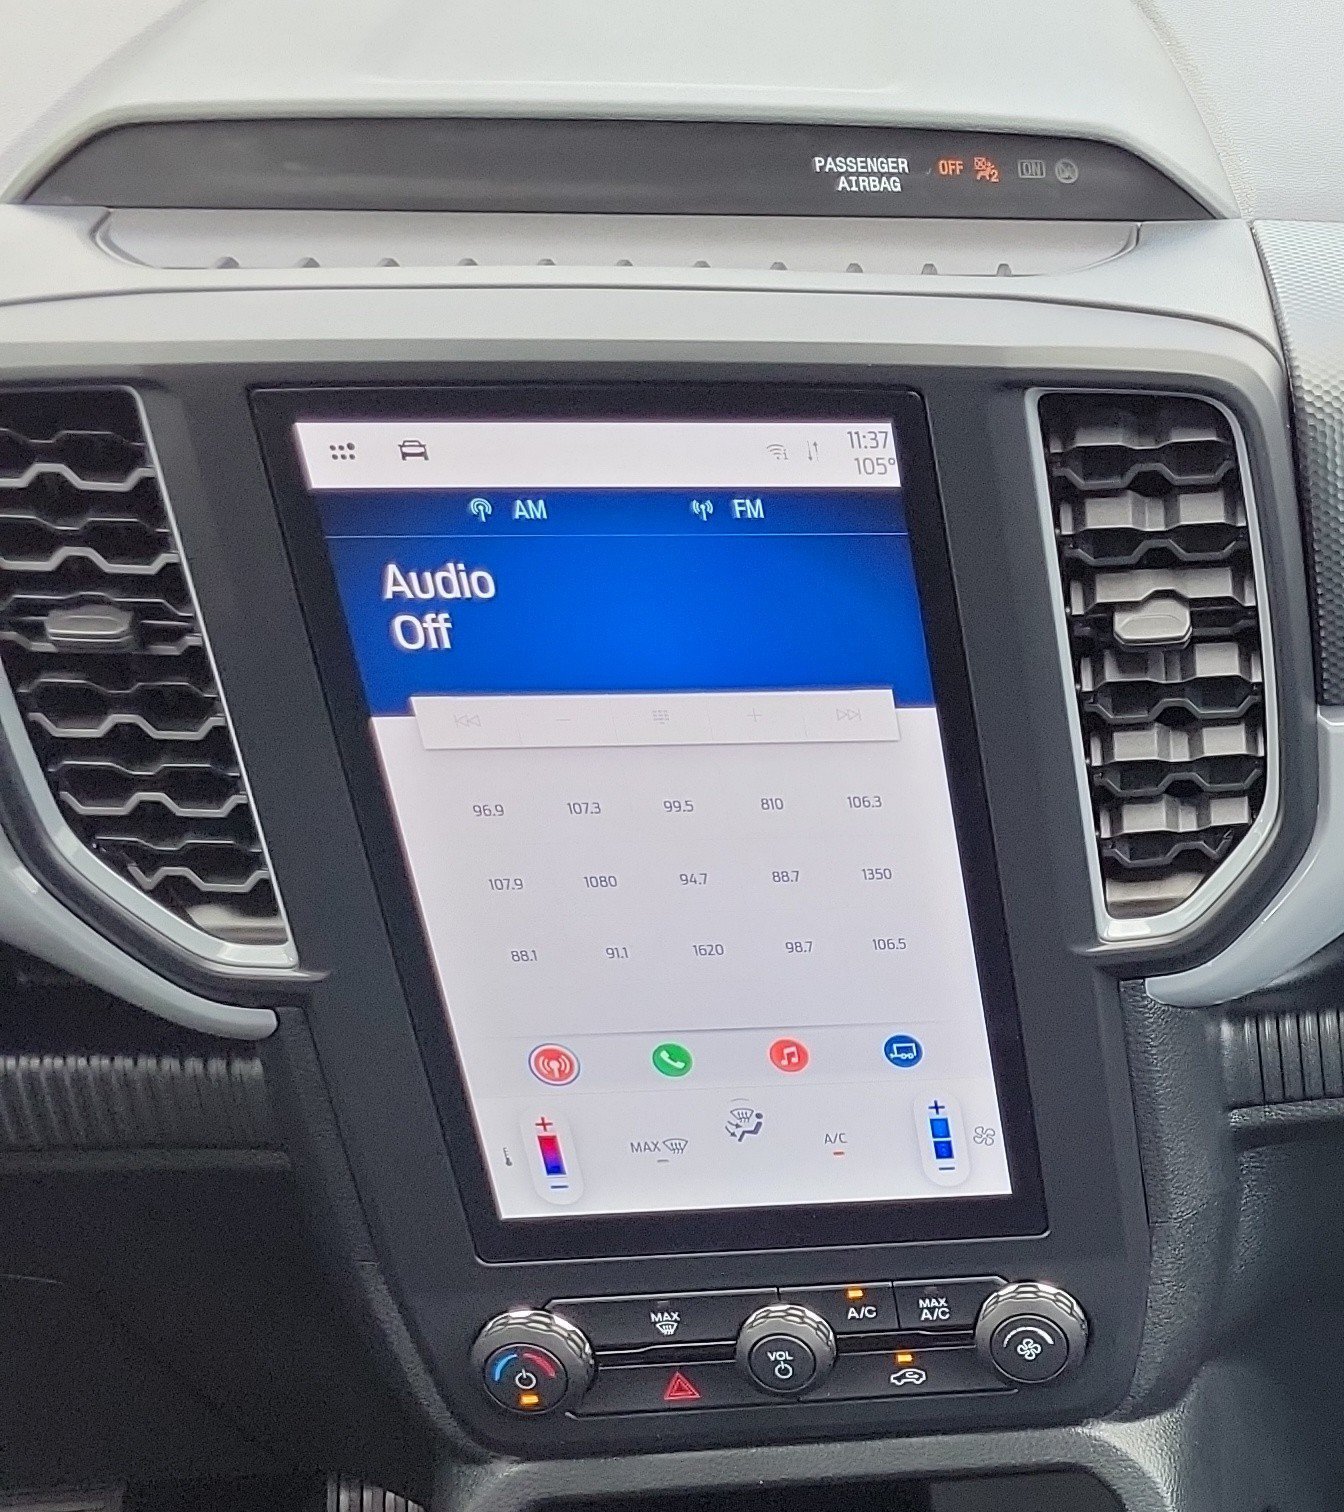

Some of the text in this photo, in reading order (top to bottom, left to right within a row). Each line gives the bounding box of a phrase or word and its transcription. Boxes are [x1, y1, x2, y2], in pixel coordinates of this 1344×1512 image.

[815, 157, 909, 173] PASSENGER
[939, 160, 963, 175] OFF
[1024, 162, 1041, 176] ON
[838, 175, 901, 192] AIRBAG
[847, 431, 888, 449] 11:37
[854, 457, 896, 475] 105°
[514, 499, 547, 519] AM
[733, 499, 764, 518] FM
[383, 562, 496, 600] Audio
[393, 613, 453, 650] Off
[566, 802, 602, 815] 107.3
[663, 800, 694, 813] 99.5
[760, 798, 784, 811] 810
[846, 796, 883, 809] 106.3
[472, 805, 505, 817] 96.9
[679, 873, 708, 886] 94.7
[771, 871, 800, 883] 88.7
[861, 868, 893, 881] 1350
[488, 879, 525, 891] 107.9
[583, 876, 618, 888] 1080
[692, 944, 725, 957] 1620
[785, 941, 813, 954] 98.7
[872, 938, 907, 951] 106.5
[510, 949, 538, 963] 88.1
[605, 947, 629, 959] 91.1
[825, 1133, 847, 1144] A/C
[631, 1141, 661, 1153] MAX
[918, 1298, 947, 1308] MAX
[650, 1311, 680, 1322] MAX
[848, 1306, 877, 1319] A/C
[920, 1308, 949, 1320] A/C
[768, 1351, 793, 1361] VOL
